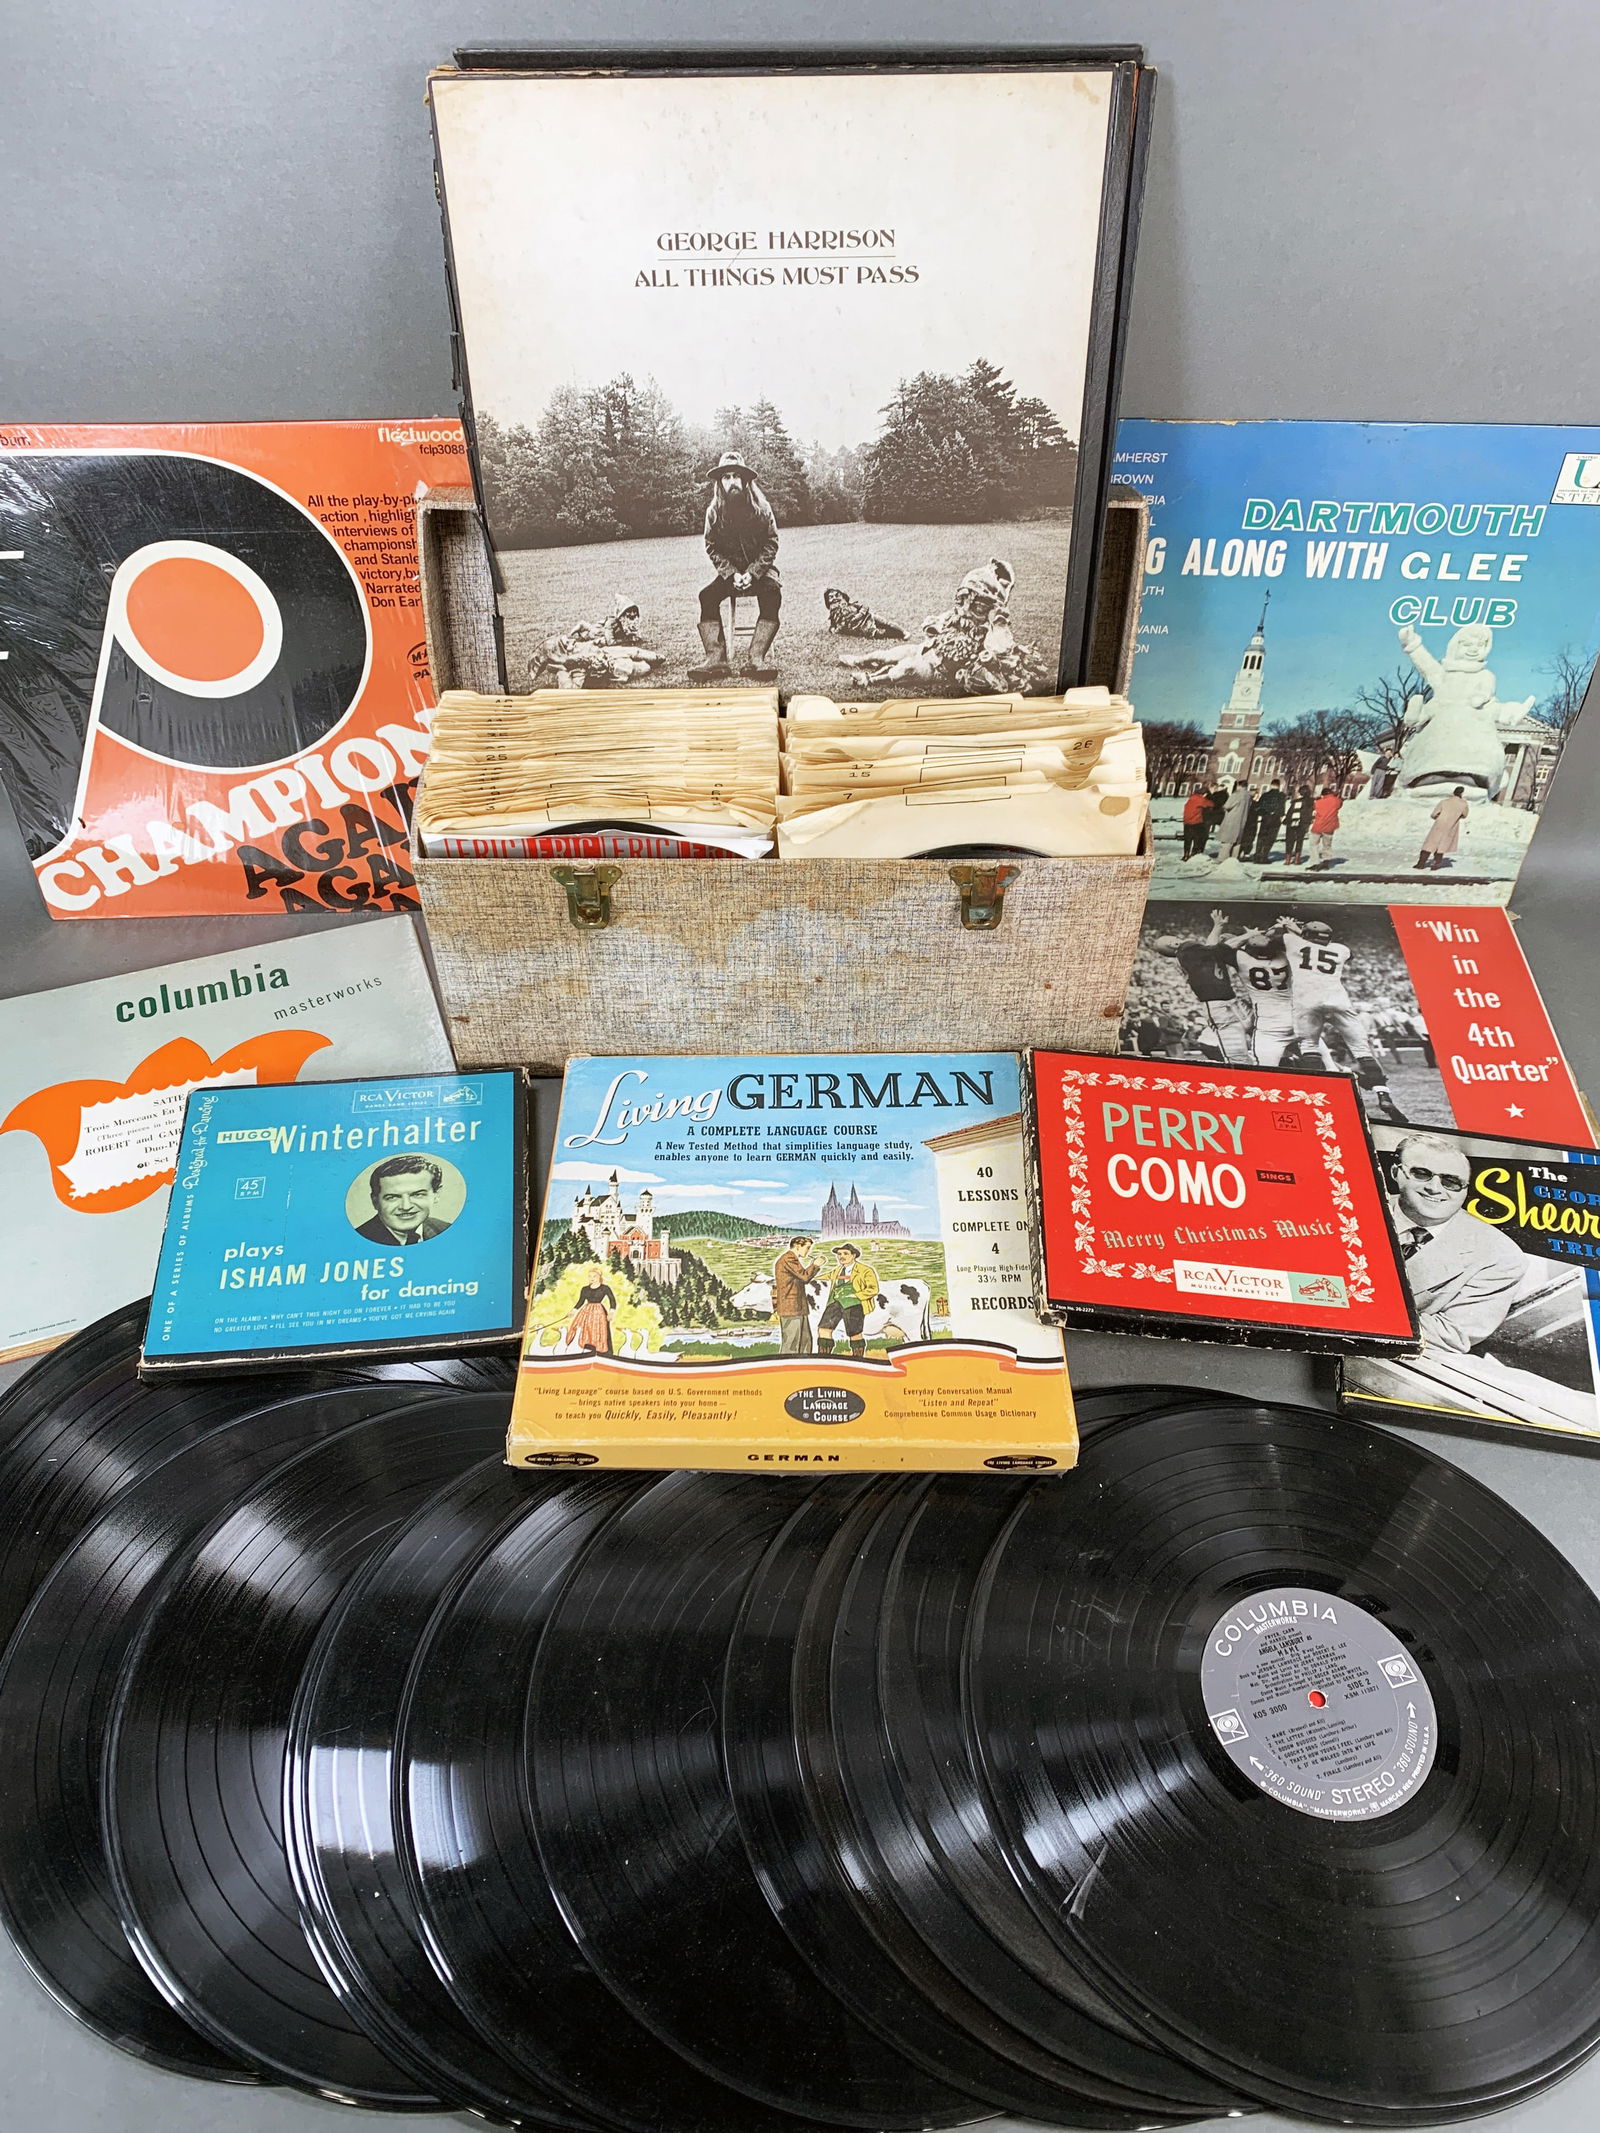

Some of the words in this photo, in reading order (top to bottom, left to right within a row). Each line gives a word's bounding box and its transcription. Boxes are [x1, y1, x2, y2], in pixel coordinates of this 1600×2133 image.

[657, 231, 757, 252] GEORGE
[769, 228, 896, 250] HARRISON
[635, 268, 679, 287] ALL
[684, 266, 775, 287] THINGS
[782, 266, 849, 286] MUST
[857, 265, 920, 284] PASS
[419, 444, 466, 456] fclp3088
[1113, 452, 1168, 464] MHERST
[307, 495, 324, 507] All
[328, 495, 349, 507] the
[320, 511, 359, 522] action
[1242, 498, 1547, 537] DARTMOUTH
[333, 525, 398, 537] interviews
[401, 524, 414, 536] of
[354, 554, 378, 565] and
[1181, 538, 1288, 578] ALONG
[1305, 540, 1389, 580] WITH
[1400, 551, 1529, 582] GLEE
[366, 582, 421, 594] Narrated
[371, 597, 395, 608] Don
[1389, 595, 1518, 629] CLUB
[843, 792, 852, 800] 7
[1415, 920, 1480, 943] “Win
[1298, 946, 1339, 974] 15
[1453, 955, 1480, 975] in
[1248, 966, 1290, 991] 87
[115, 963, 290, 1023] columbia
[273, 977, 383, 1021] masterworks
[1453, 988, 1501, 1010] the
[1467, 1023, 1515, 1048] 4th
[1452, 1056, 1559, 1083] Quarter”
[360, 1094, 383, 1102] RCA
[384, 1089, 434, 1102] VICTOR
[563, 1069, 722, 1149] Living
[726, 1070, 995, 1110] GERMAN
[1277, 1114, 1294, 1124] 45
[687, 1126, 695, 1136] A
[700, 1126, 761, 1136] COMPLETE
[767, 1125, 828, 1136] LANGUAGE
[833, 1125, 878, 1136] COURSE
[1102, 1101, 1246, 1155] PERRY
[222, 1130, 271, 1141] HUGO
[269, 1117, 482, 1154] Winterhalter
[85, 1140, 131, 1156] ROBERT
[136, 1135, 153, 1145] and
[655, 1141, 662, 1150] A
[665, 1141, 686, 1150] New
[688, 1141, 720, 1151] Tested
[723, 1141, 758, 1151] Method
[762, 1141, 781, 1150] that
[785, 1140, 833, 1153] simplifies
[836, 1140, 881, 1152] language
[884, 1140, 913, 1152] study,
[654, 1152, 691, 1161] enables
[694, 1153, 729, 1163] anyone
[733, 1152, 742, 1161] to
[746, 1152, 772, 1161] learn
[776, 1152, 817, 1162] GERMAN
[821, 1151, 858, 1163] quickly
[860, 1151, 879, 1161] and
[882, 1151, 915, 1163] easily.
[976, 1166, 993, 1178] 40
[1260, 1173, 1292, 1182] SINGS
[1528, 1166, 1568, 1183] The
[240, 1180, 259, 1190] 45
[1107, 1153, 1247, 1210] COMO
[958, 1189, 1019, 1202] LESSONS
[181, 1194, 195, 1230] ALBUMS
[952, 1221, 1010, 1233] COMPLETE
[178, 1235, 187, 1246] OF
[1101, 1229, 1165, 1250] Merry
[1173, 1223, 1267, 1246] Christmas
[1275, 1218, 1335, 1241] Music
[224, 1241, 284, 1262] plays
[991, 1242, 1000, 1255] 4
[171, 1251, 184, 1285] SERIES
[219, 1263, 307, 1289] ISHAM
[320, 1256, 405, 1283] JONES
[956, 1265, 971, 1273] Long
[973, 1264, 997, 1273] Playing
[1001, 1273, 1022, 1283] RPM
[1183, 1269, 1215, 1283] RCA
[1213, 1268, 1285, 1290] VICTOR
[361, 1284, 390, 1301] for
[398, 1279, 479, 1298] dancing
[1191, 1283, 1228, 1292] MUSICAL
[1232, 1288, 1261, 1296] SMART
[167, 1301, 176, 1314] OF
[971, 1296, 1034, 1311] RECORDS
[162, 1320, 173, 1341] ONE
[668, 1388, 683, 1396] U.S.
[686, 1388, 729, 1396] Government
[732, 1388, 762, 1396] methods
[798, 1390, 814, 1398] THE
[817, 1388, 847, 1398] LIVING
[903, 1387, 935, 1396] Everyday
[937, 1387, 984, 1395] Conversation
[578, 1399, 601, 1407] brings
[629, 1399, 660, 1407] speakers
[803, 1400, 848, 1410] LANGUAGE
[604, 1410, 641, 1421] Quickly,
[646, 1410, 677, 1421] Easily,
[681, 1410, 738, 1421] Pleasantly!
[813, 1412, 849, 1422] COURSE
[884, 1410, 938, 1418] Comprehensive
[975, 1410, 997, 1418] Usage
[1000, 1409, 1037, 1419] Dictionary
[747, 1453, 840, 1462] GERMAN
[1215, 1600, 1338, 1658] COLUMBIA
[1253, 1616, 1298, 1635] MASTERWORKS
[1347, 1681, 1364, 1691] SIDE
[1364, 1678, 1371, 1686] 2
[1253, 1710, 1268, 1720] KOS
[1269, 1703, 1288, 1715] 3000
[1331, 1771, 1395, 1805] STEREO
